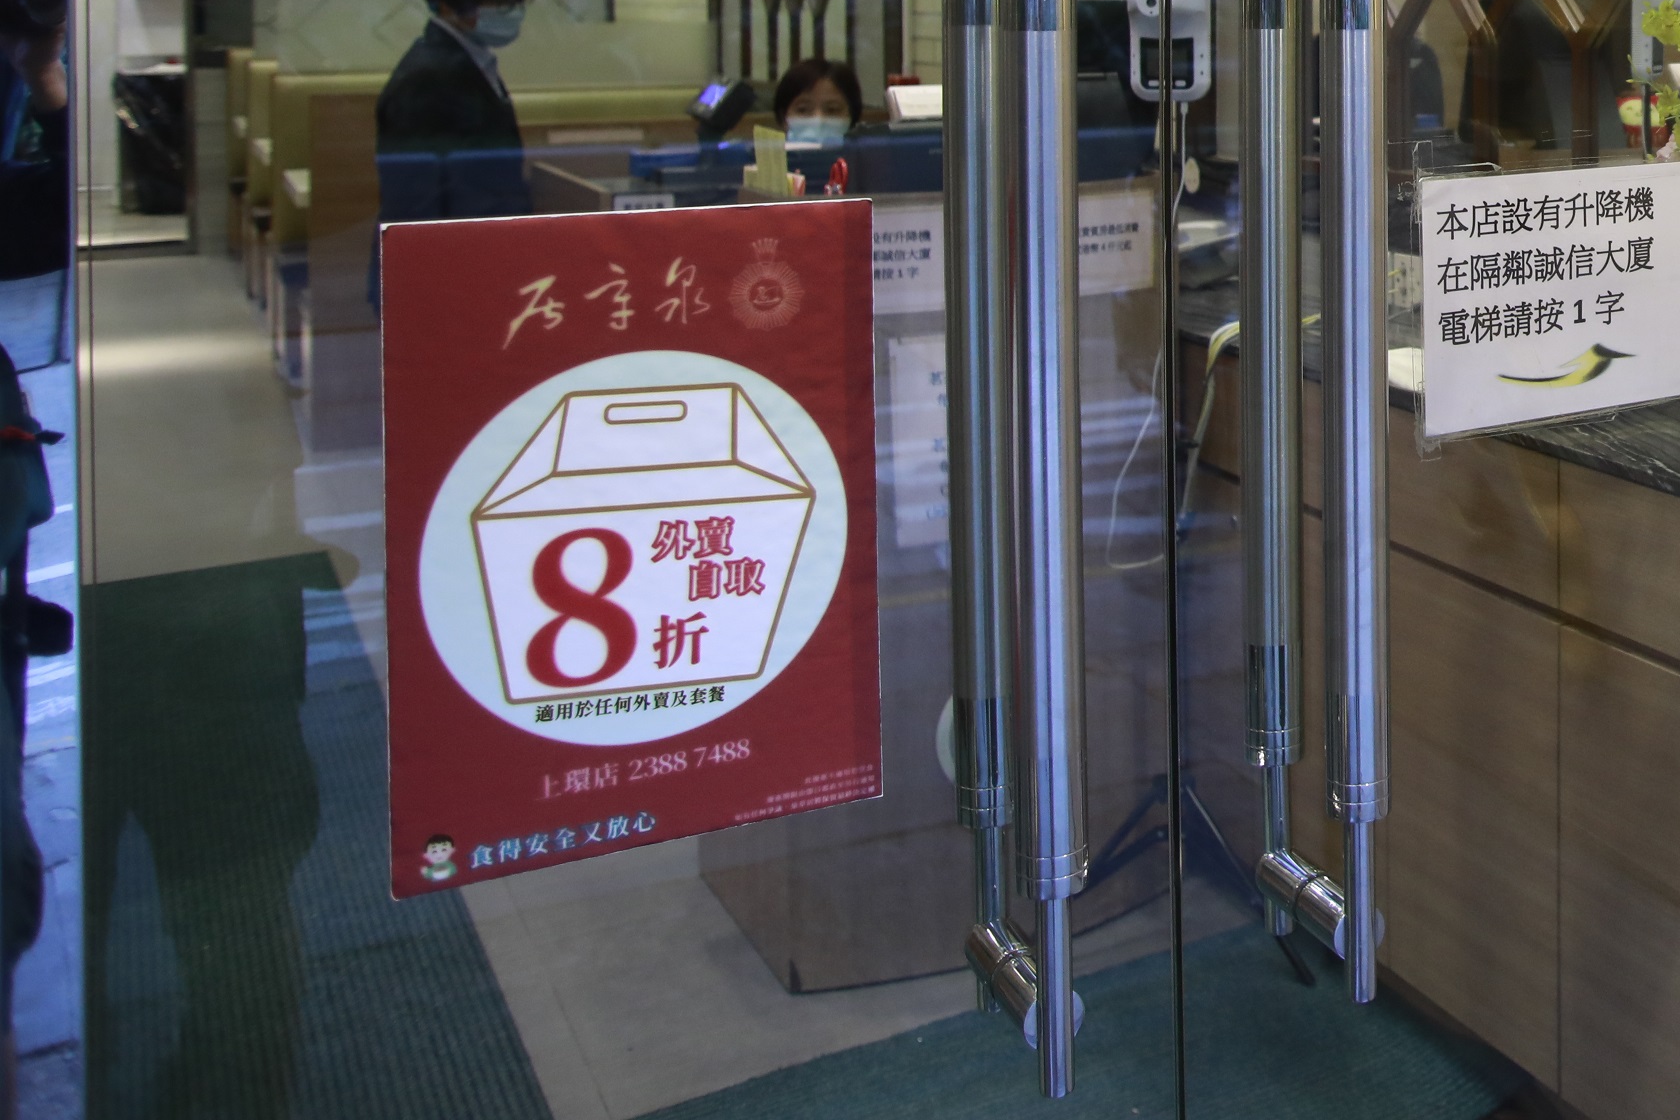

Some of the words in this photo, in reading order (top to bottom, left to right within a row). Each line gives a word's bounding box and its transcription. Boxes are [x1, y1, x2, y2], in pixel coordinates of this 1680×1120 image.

[1436, 186, 1654, 240] 本店設有升降機
[1437, 236, 1654, 294] 在隔鄰誠信大廈
[1438, 297, 1565, 346] 電梯請按
[1573, 299, 1586, 323] 1
[1595, 290, 1625, 325] 字
[651, 515, 737, 564] 外賣
[525, 527, 638, 688] 8
[652, 611, 710, 670] 折
[687, 558, 766, 602] 自取
[535, 685, 726, 724] 適用於任何外賣及套餐
[535, 762, 619, 801] 上環店
[628, 750, 688, 781] 2388
[693, 738, 751, 768] 7488
[470, 810, 656, 870] 食得安全又放心
